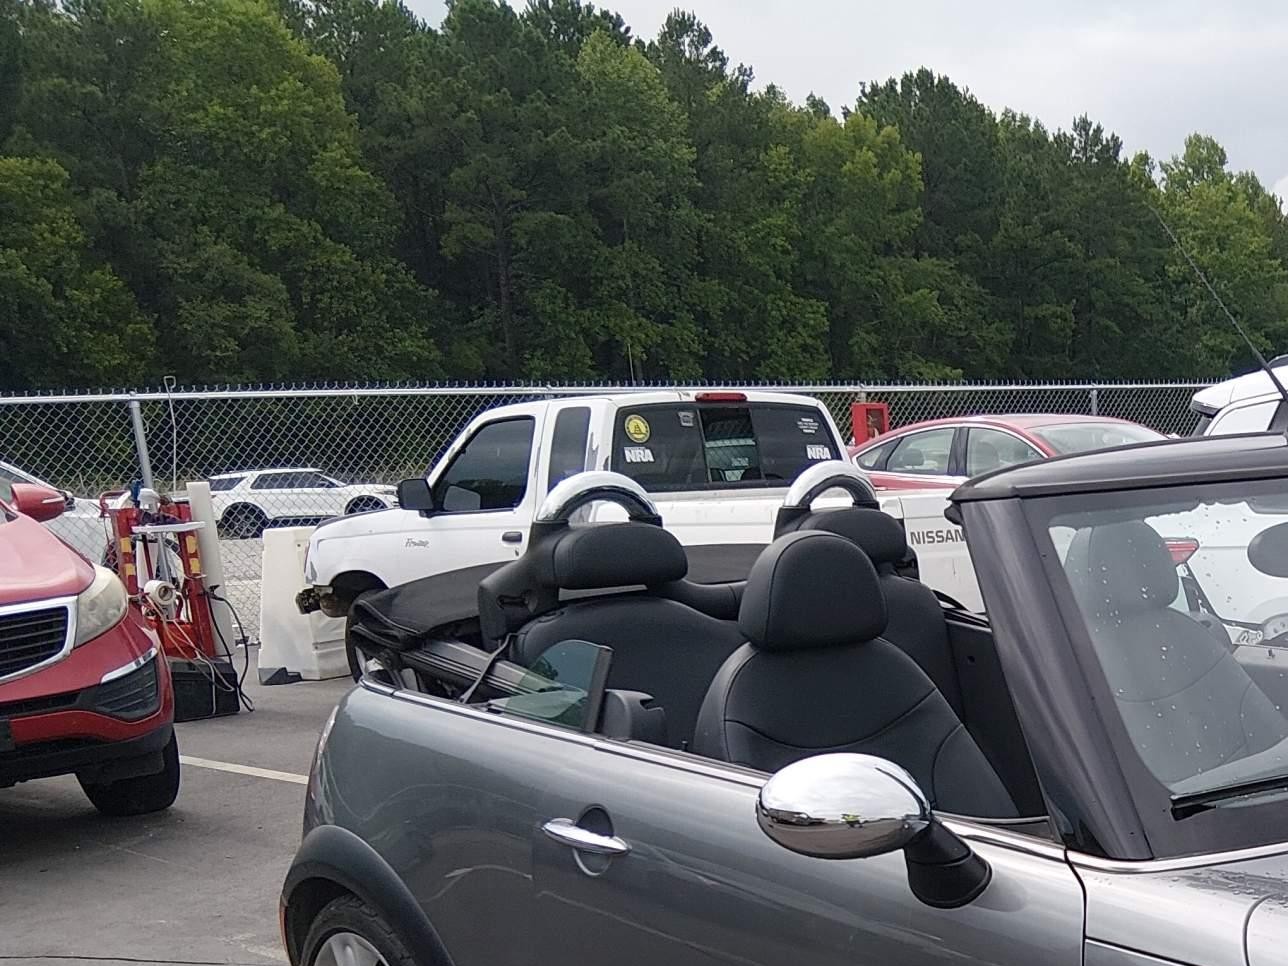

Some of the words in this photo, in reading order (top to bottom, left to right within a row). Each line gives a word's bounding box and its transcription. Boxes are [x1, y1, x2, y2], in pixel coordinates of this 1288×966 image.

[624, 448, 655, 463] NRA
[807, 446, 831, 460] NRA
[910, 529, 965, 545] NISSAN
